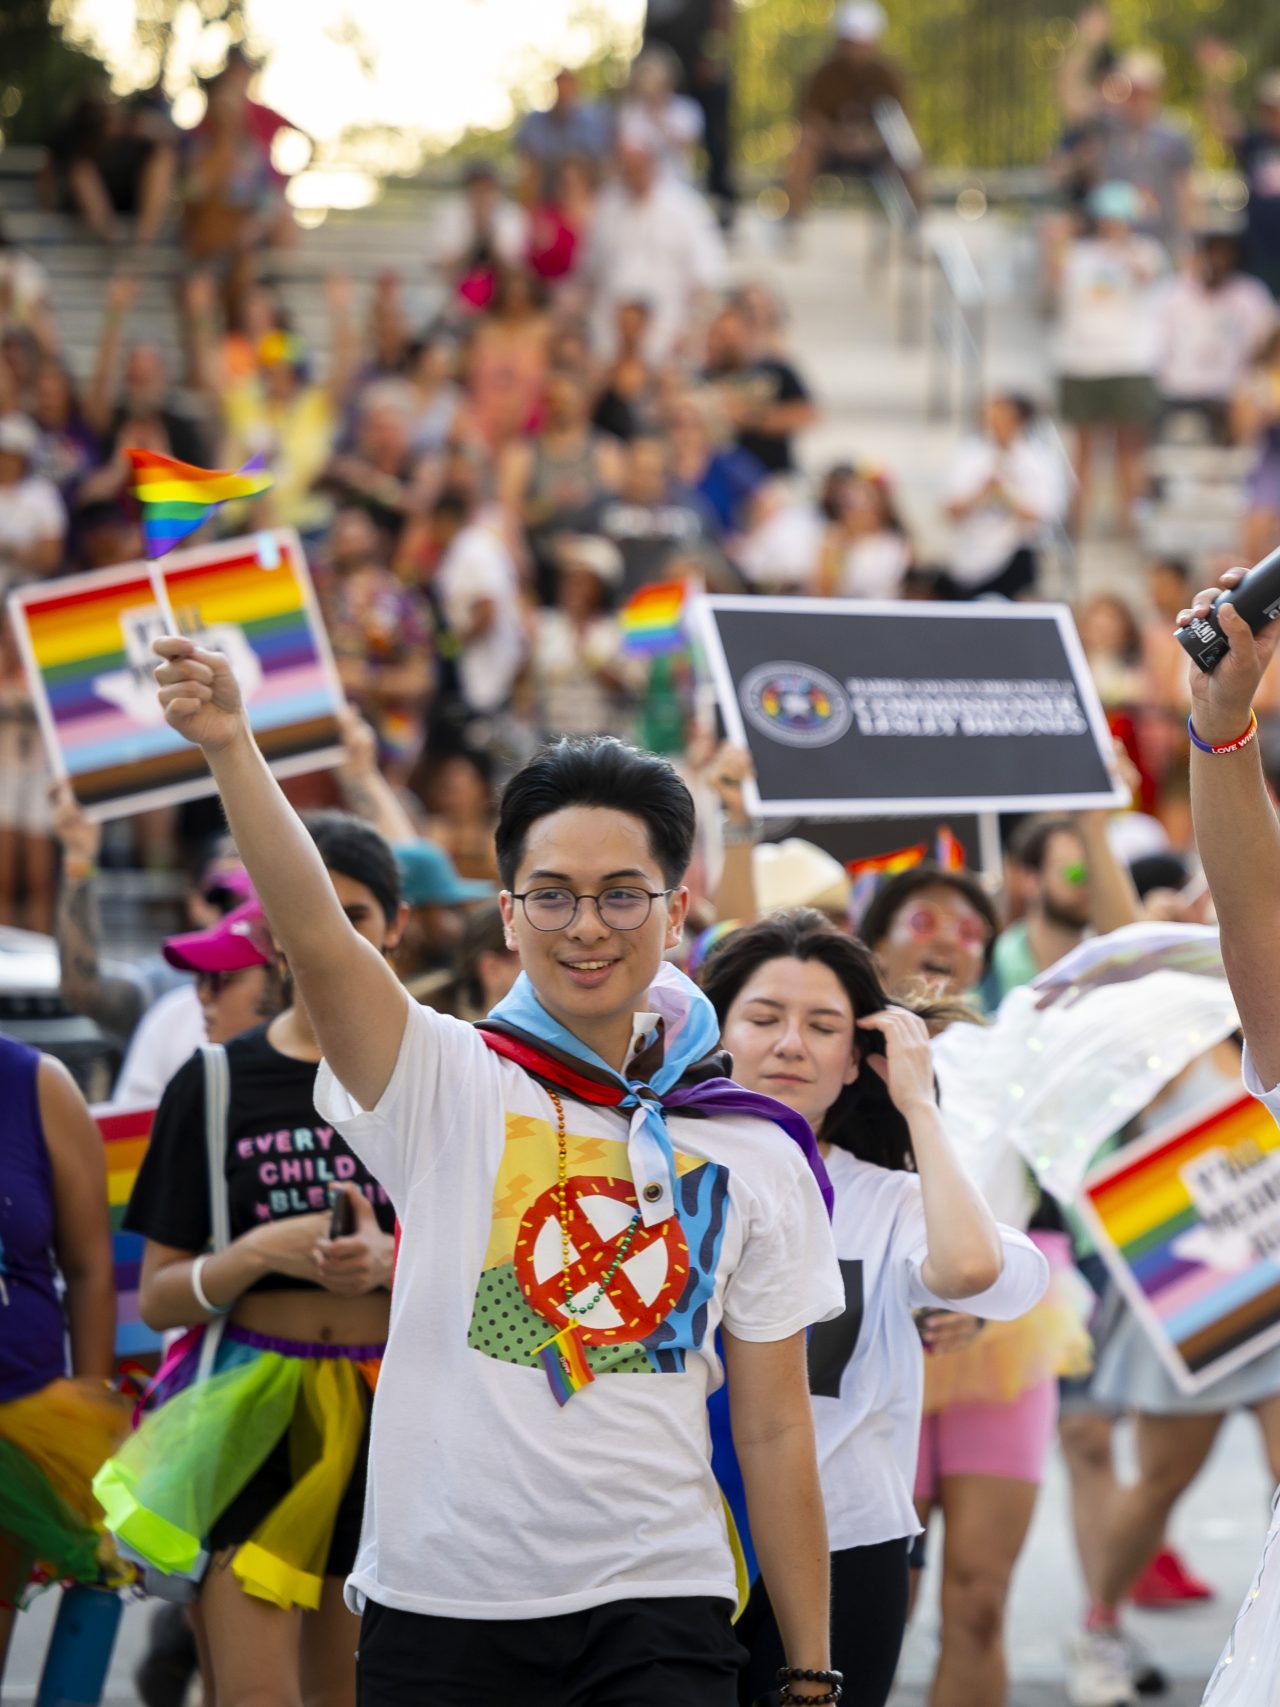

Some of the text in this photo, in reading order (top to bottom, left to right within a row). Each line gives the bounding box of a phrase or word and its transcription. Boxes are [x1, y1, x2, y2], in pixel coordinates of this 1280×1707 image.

[1211, 744, 1238, 754] LOVE
[237, 1126, 334, 1159] EVERY
[259, 1154, 356, 1185] CHILD
